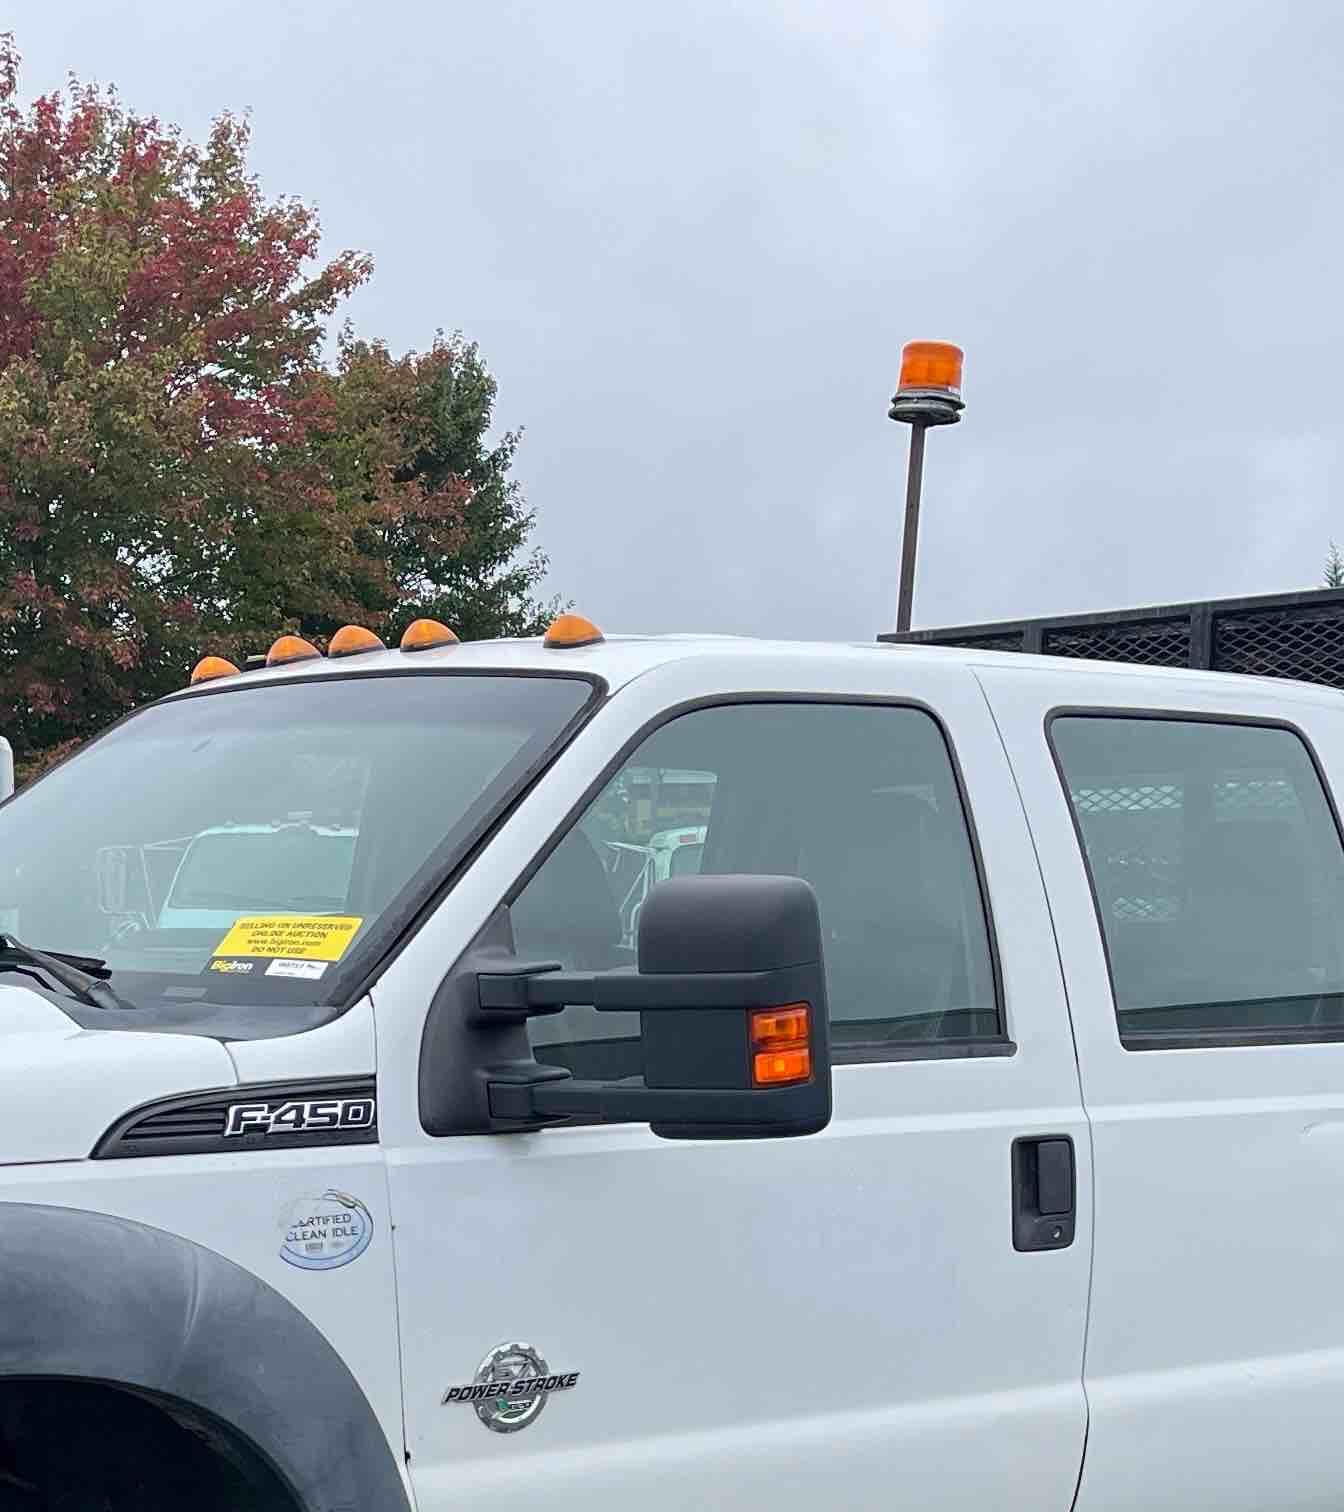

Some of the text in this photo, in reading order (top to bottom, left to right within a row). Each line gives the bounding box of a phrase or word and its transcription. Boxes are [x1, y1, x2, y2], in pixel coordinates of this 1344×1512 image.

[277, 922, 291, 930] ON
[251, 930, 329, 939] ONLINE AUCTION
[266, 946, 286, 954] NOT
[223, 1098, 375, 1137] F-450
[285, 1225, 359, 1242] CLEAN IDLE
[444, 1372, 581, 1403] POWER STROKE
